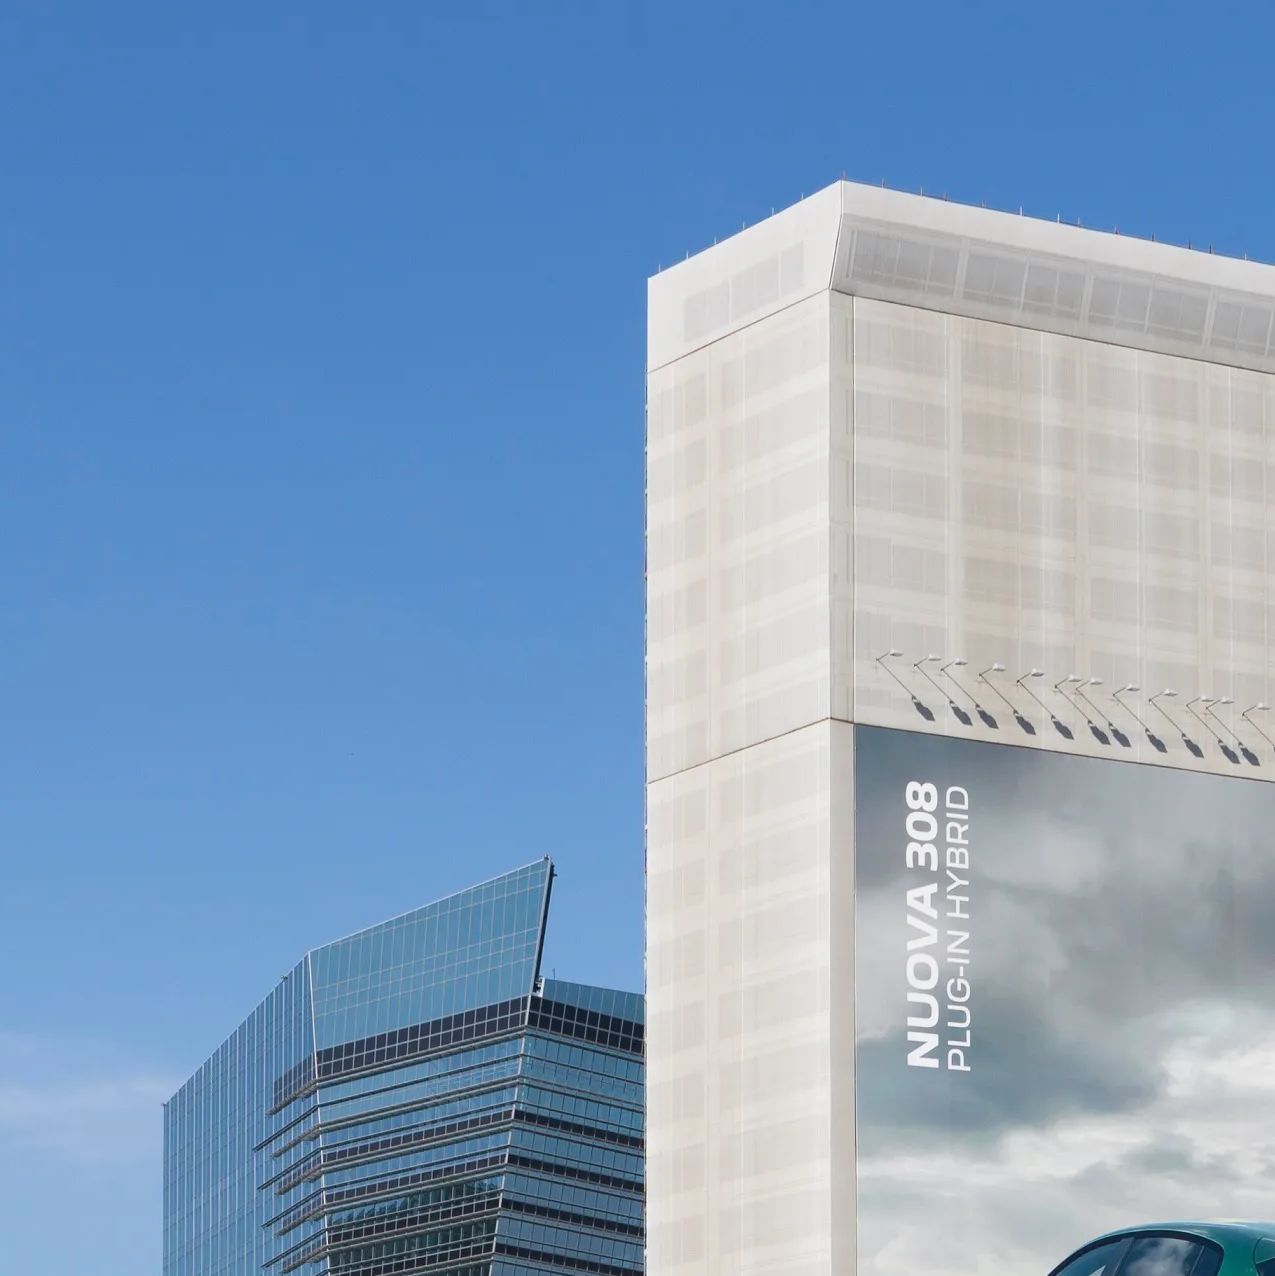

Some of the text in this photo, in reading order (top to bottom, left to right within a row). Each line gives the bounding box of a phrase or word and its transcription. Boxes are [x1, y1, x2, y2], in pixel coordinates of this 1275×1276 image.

[906, 781, 939, 1068] NUOVA 308
[945, 786, 971, 1072] PLUG-IN HYBRID
